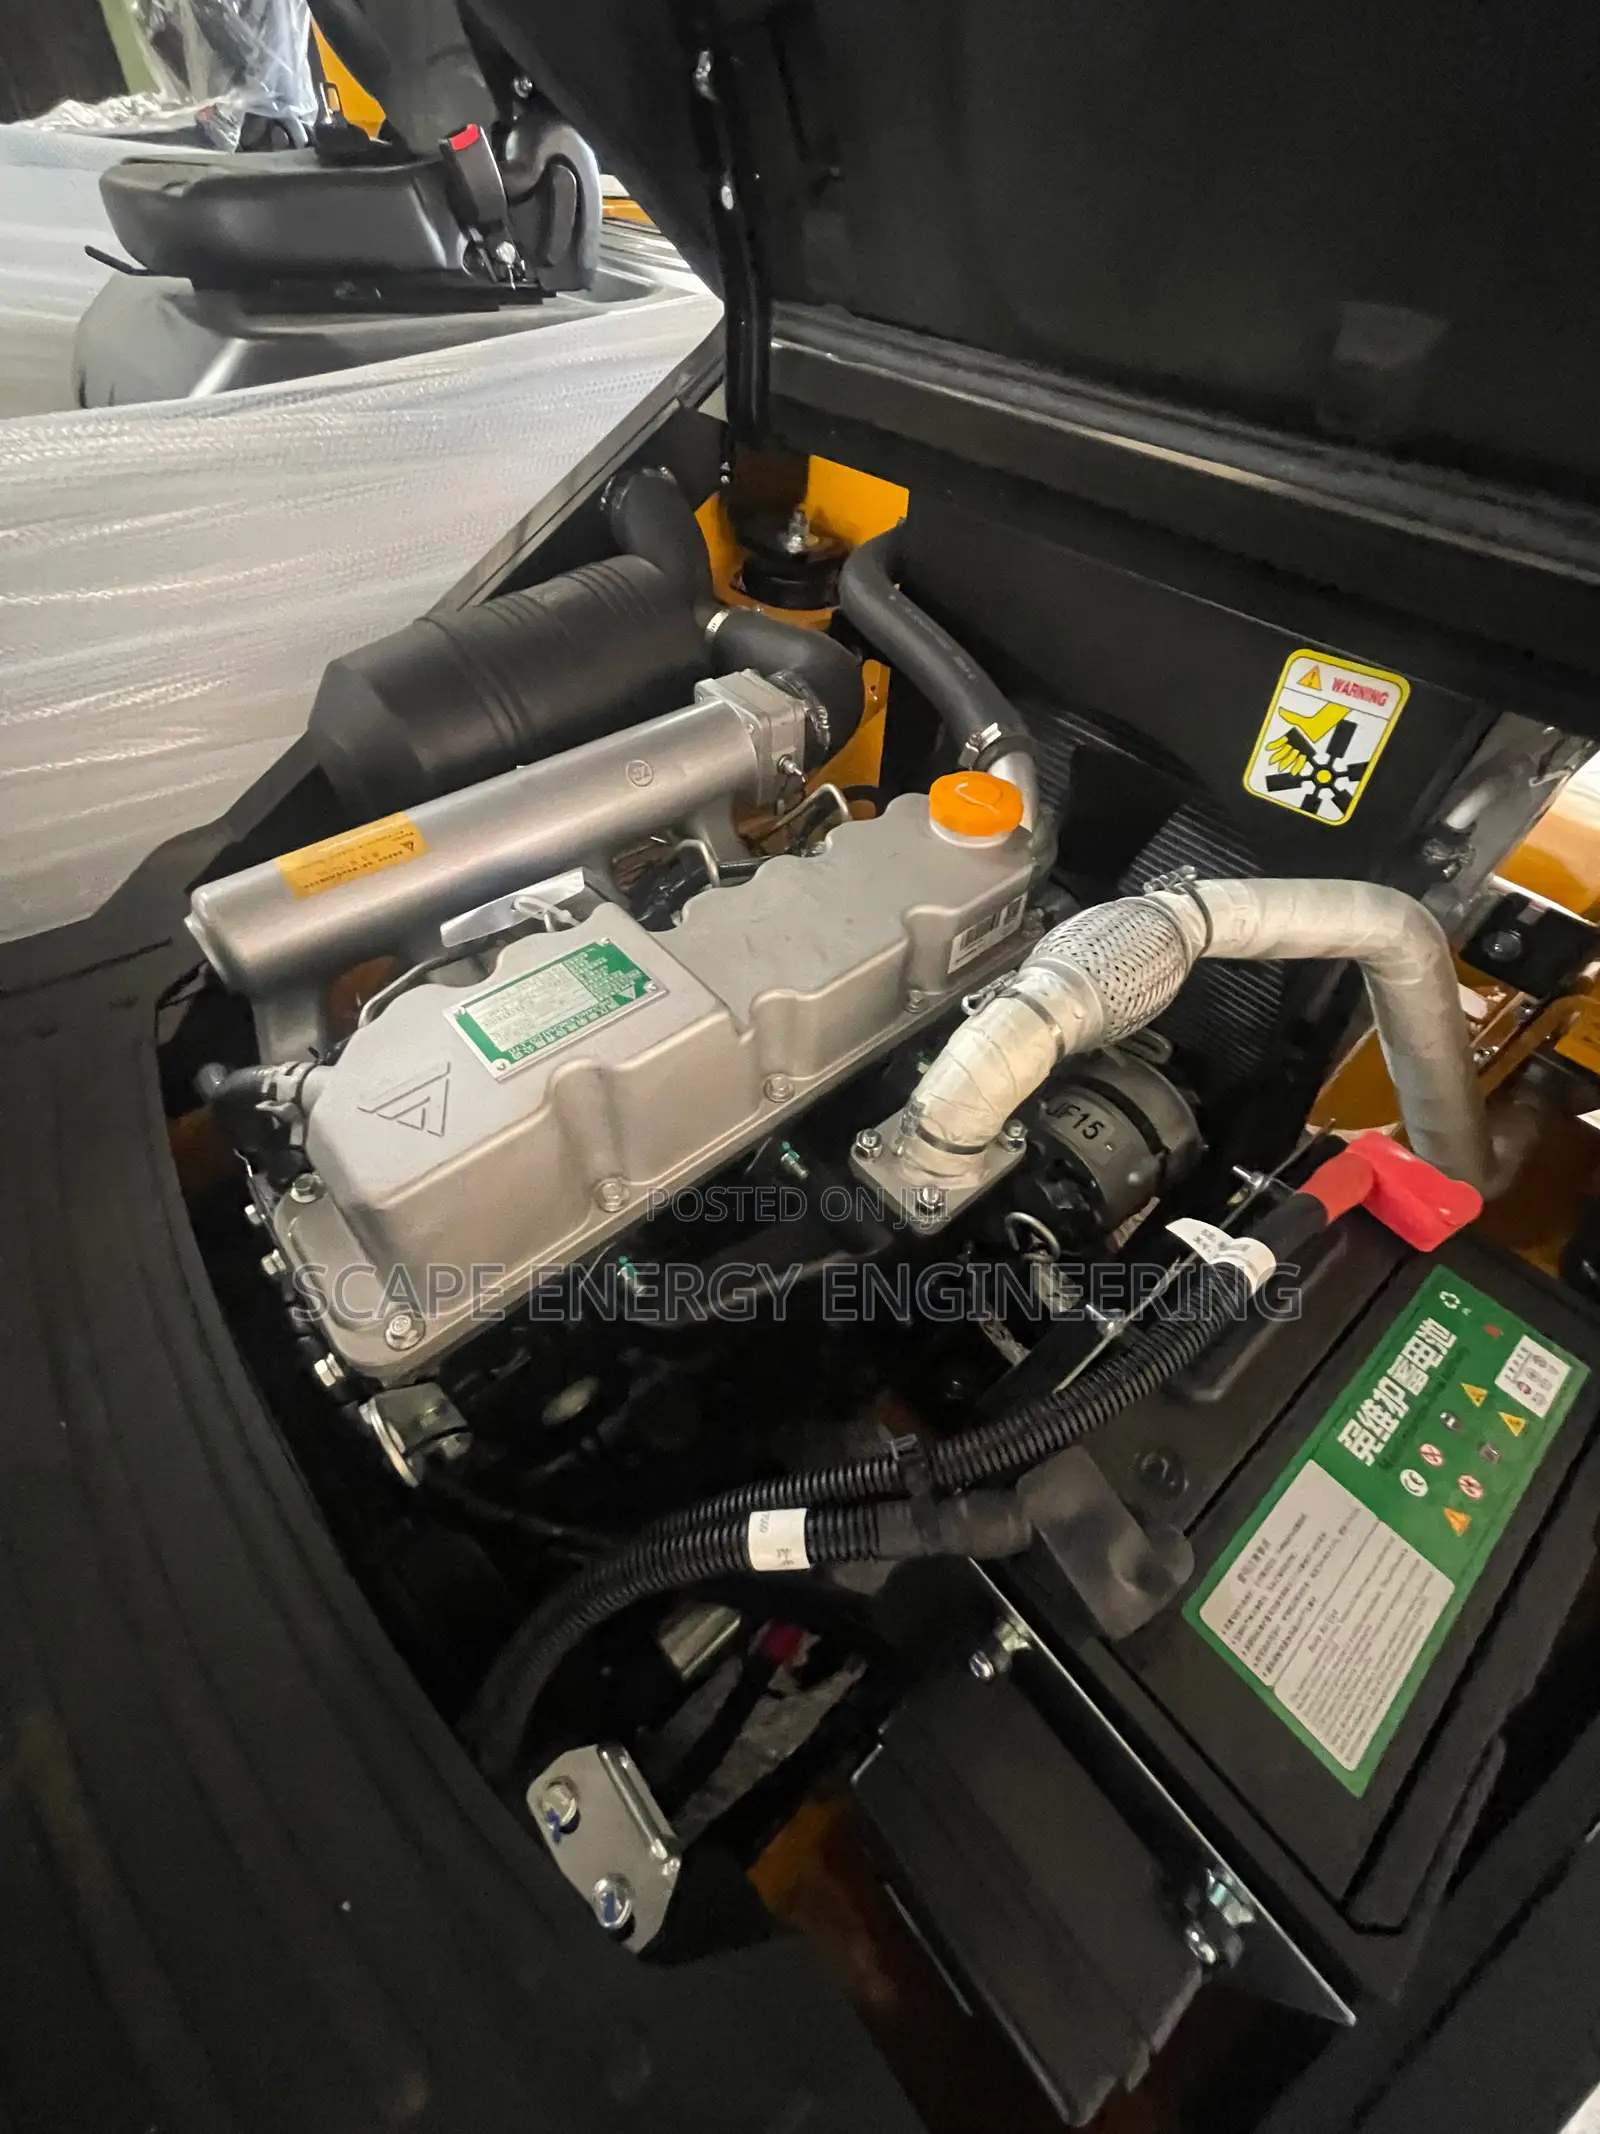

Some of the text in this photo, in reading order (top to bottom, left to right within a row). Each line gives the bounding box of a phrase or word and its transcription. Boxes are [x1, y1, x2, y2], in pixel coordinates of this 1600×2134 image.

[1332, 677, 1389, 707] WARNING
[1337, 1317, 1458, 1467] 免维护蓄电池
